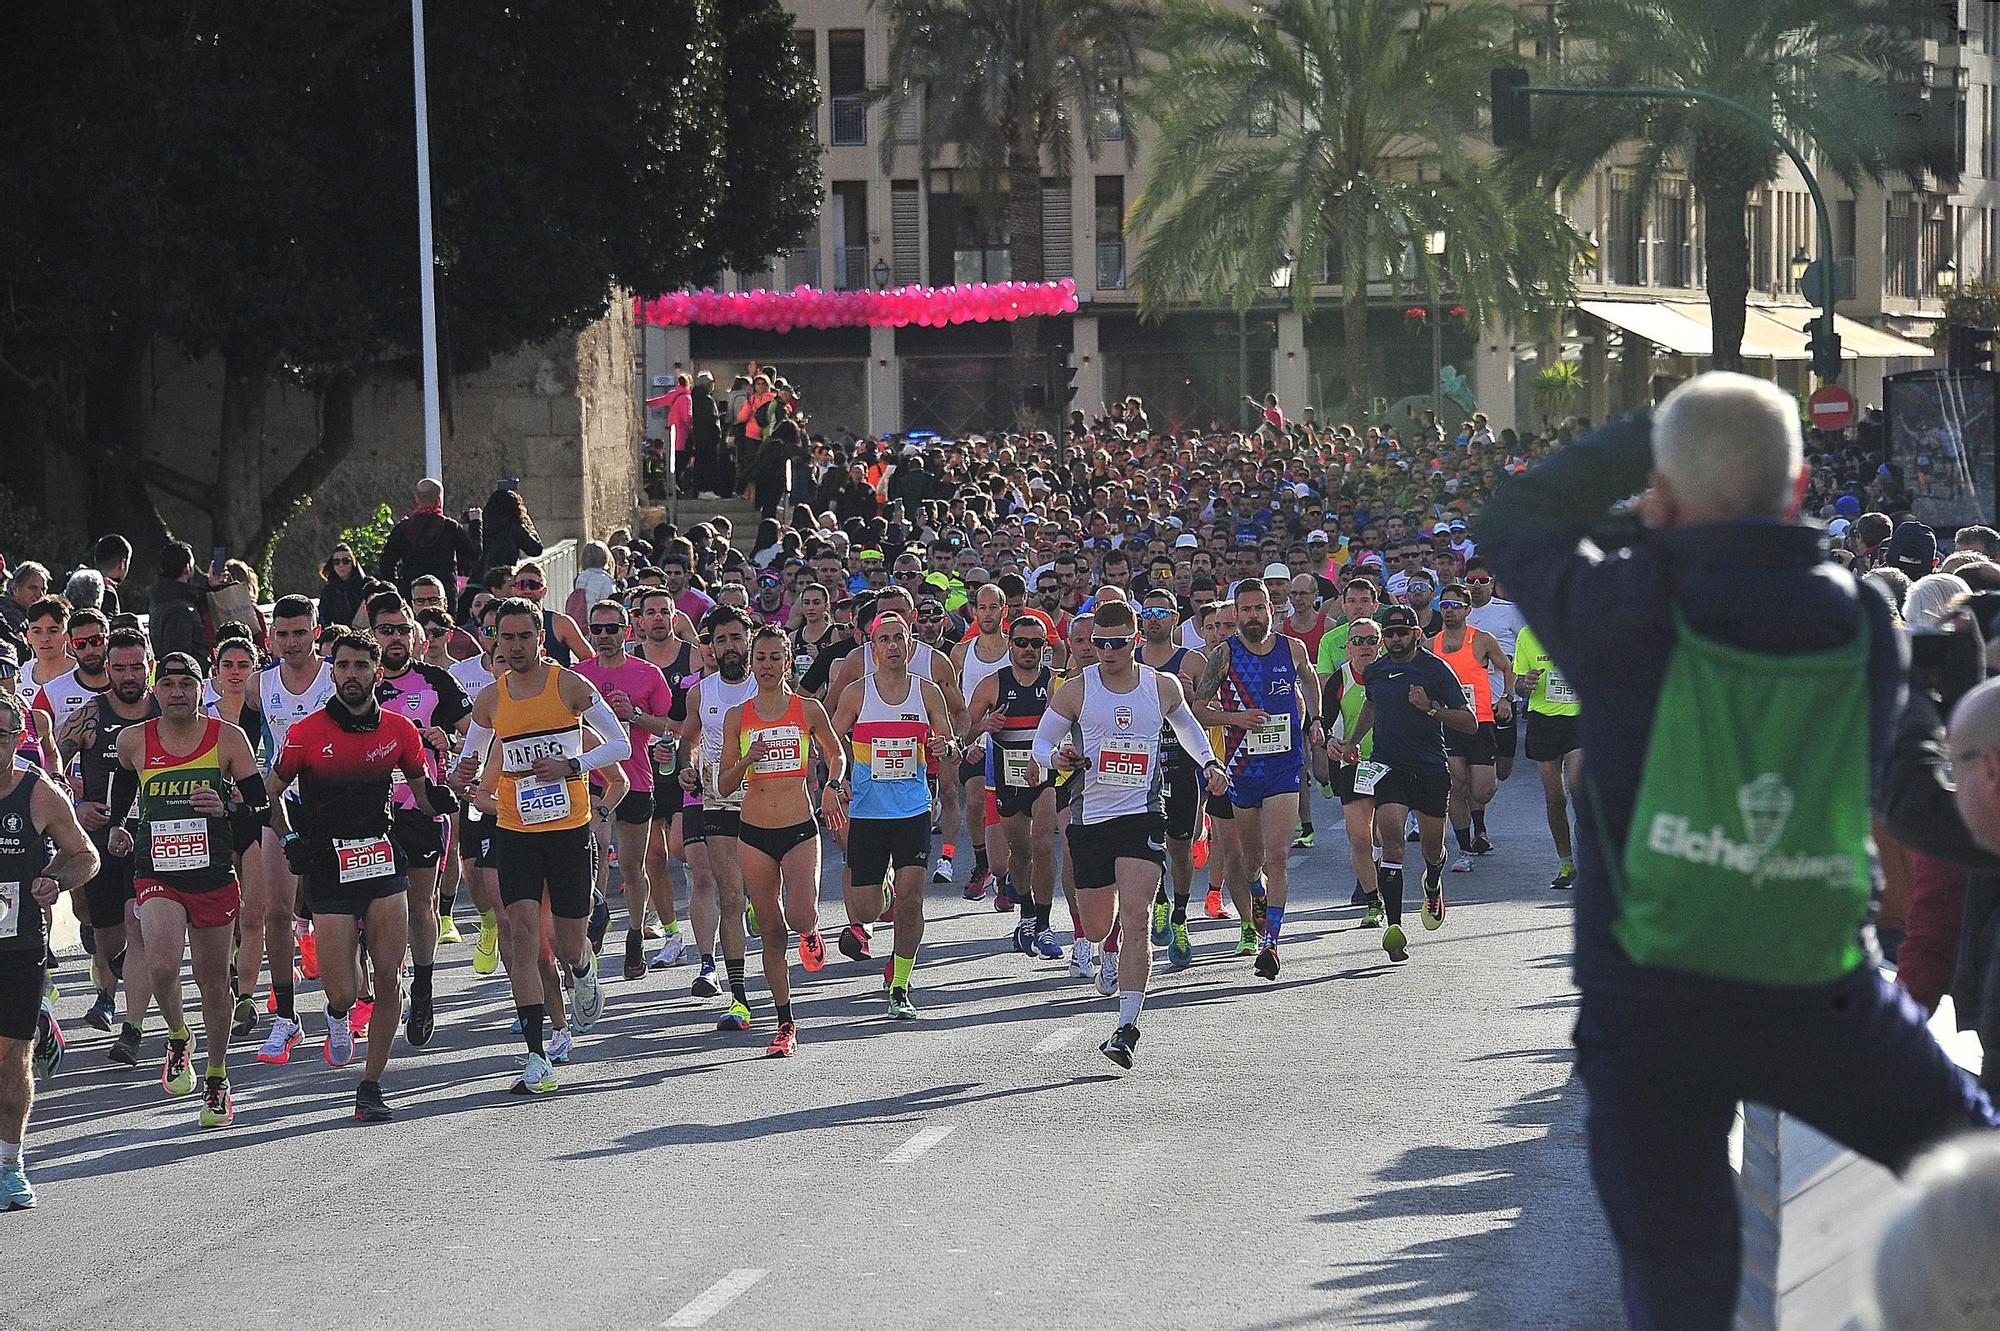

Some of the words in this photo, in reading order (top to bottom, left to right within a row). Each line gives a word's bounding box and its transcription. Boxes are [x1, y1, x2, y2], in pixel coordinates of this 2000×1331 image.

[1257, 733, 1280, 744] 183
[884, 759, 904, 769] 36
[1105, 761, 1142, 775] 5012
[521, 794, 566, 813] 2468
[154, 834, 204, 844] ALFONSITO
[154, 844, 204, 858] 5022
[347, 851, 386, 869] 5016
